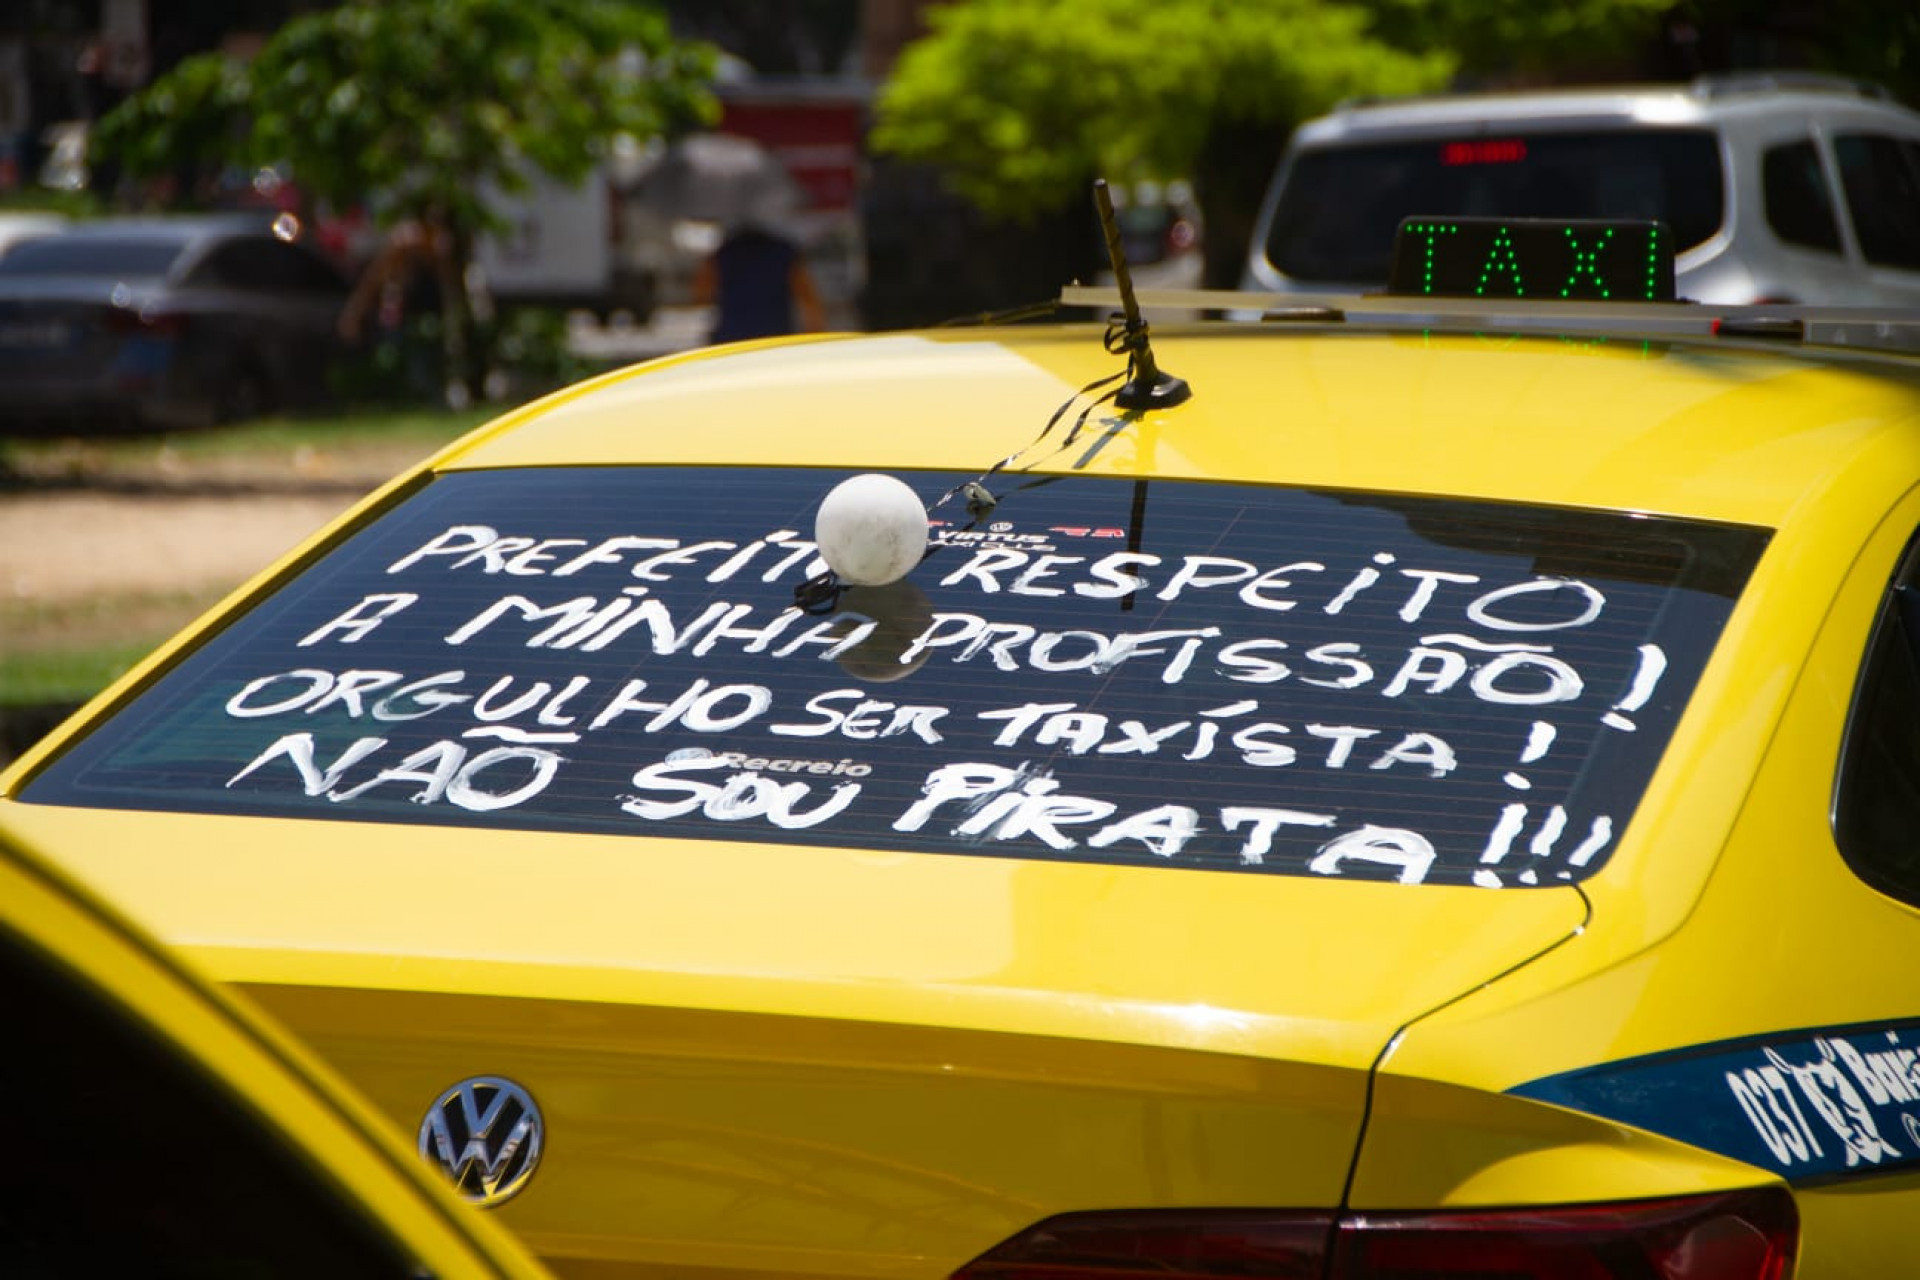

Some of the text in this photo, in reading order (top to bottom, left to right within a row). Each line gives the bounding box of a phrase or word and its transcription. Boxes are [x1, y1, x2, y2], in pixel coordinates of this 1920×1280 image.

[1404, 223, 1657, 300] TAXI
[297, 592, 418, 646] A
[444, 586, 879, 661] MINHA
[939, 547, 1606, 632] RESPEITO
[226, 668, 773, 735] ORGULHO
[769, 688, 950, 745] SER
[226, 727, 582, 811] NÃO
[616, 752, 862, 829] SOU
[1724, 1065, 1826, 1167] 037
